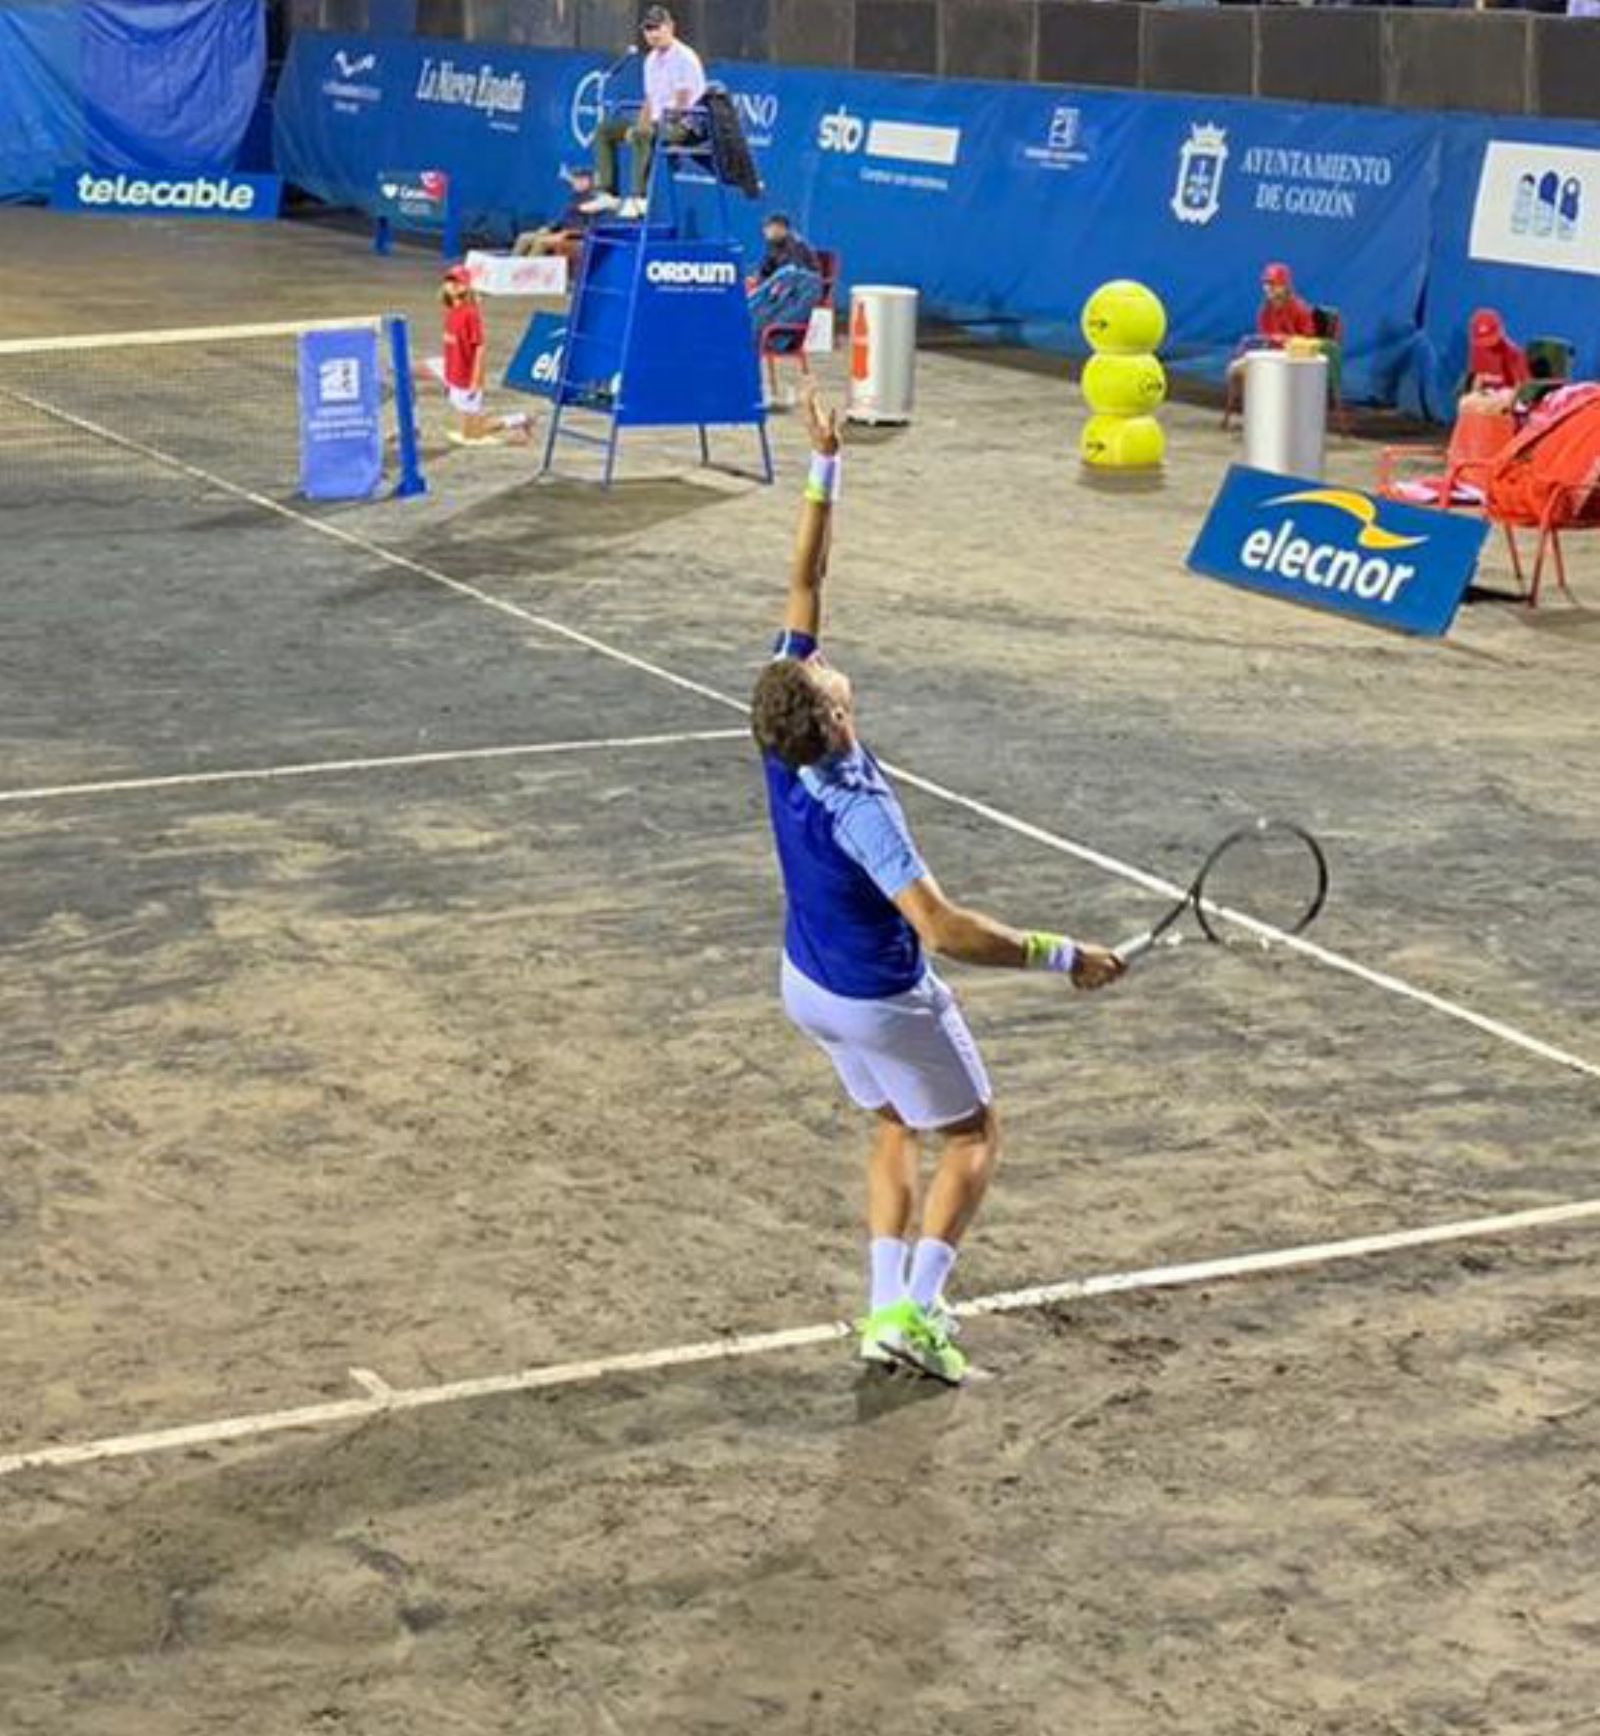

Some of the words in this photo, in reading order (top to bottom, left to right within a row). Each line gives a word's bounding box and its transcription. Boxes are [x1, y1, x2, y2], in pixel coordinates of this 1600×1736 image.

[817, 104, 864, 153] sto
[1240, 146, 1392, 186] AYUNTAMIENTO
[76, 172, 254, 211] telecable
[1255, 183, 1283, 211] DE
[1285, 182, 1356, 219] GOZÓN
[1240, 519, 1415, 603] elecnor
